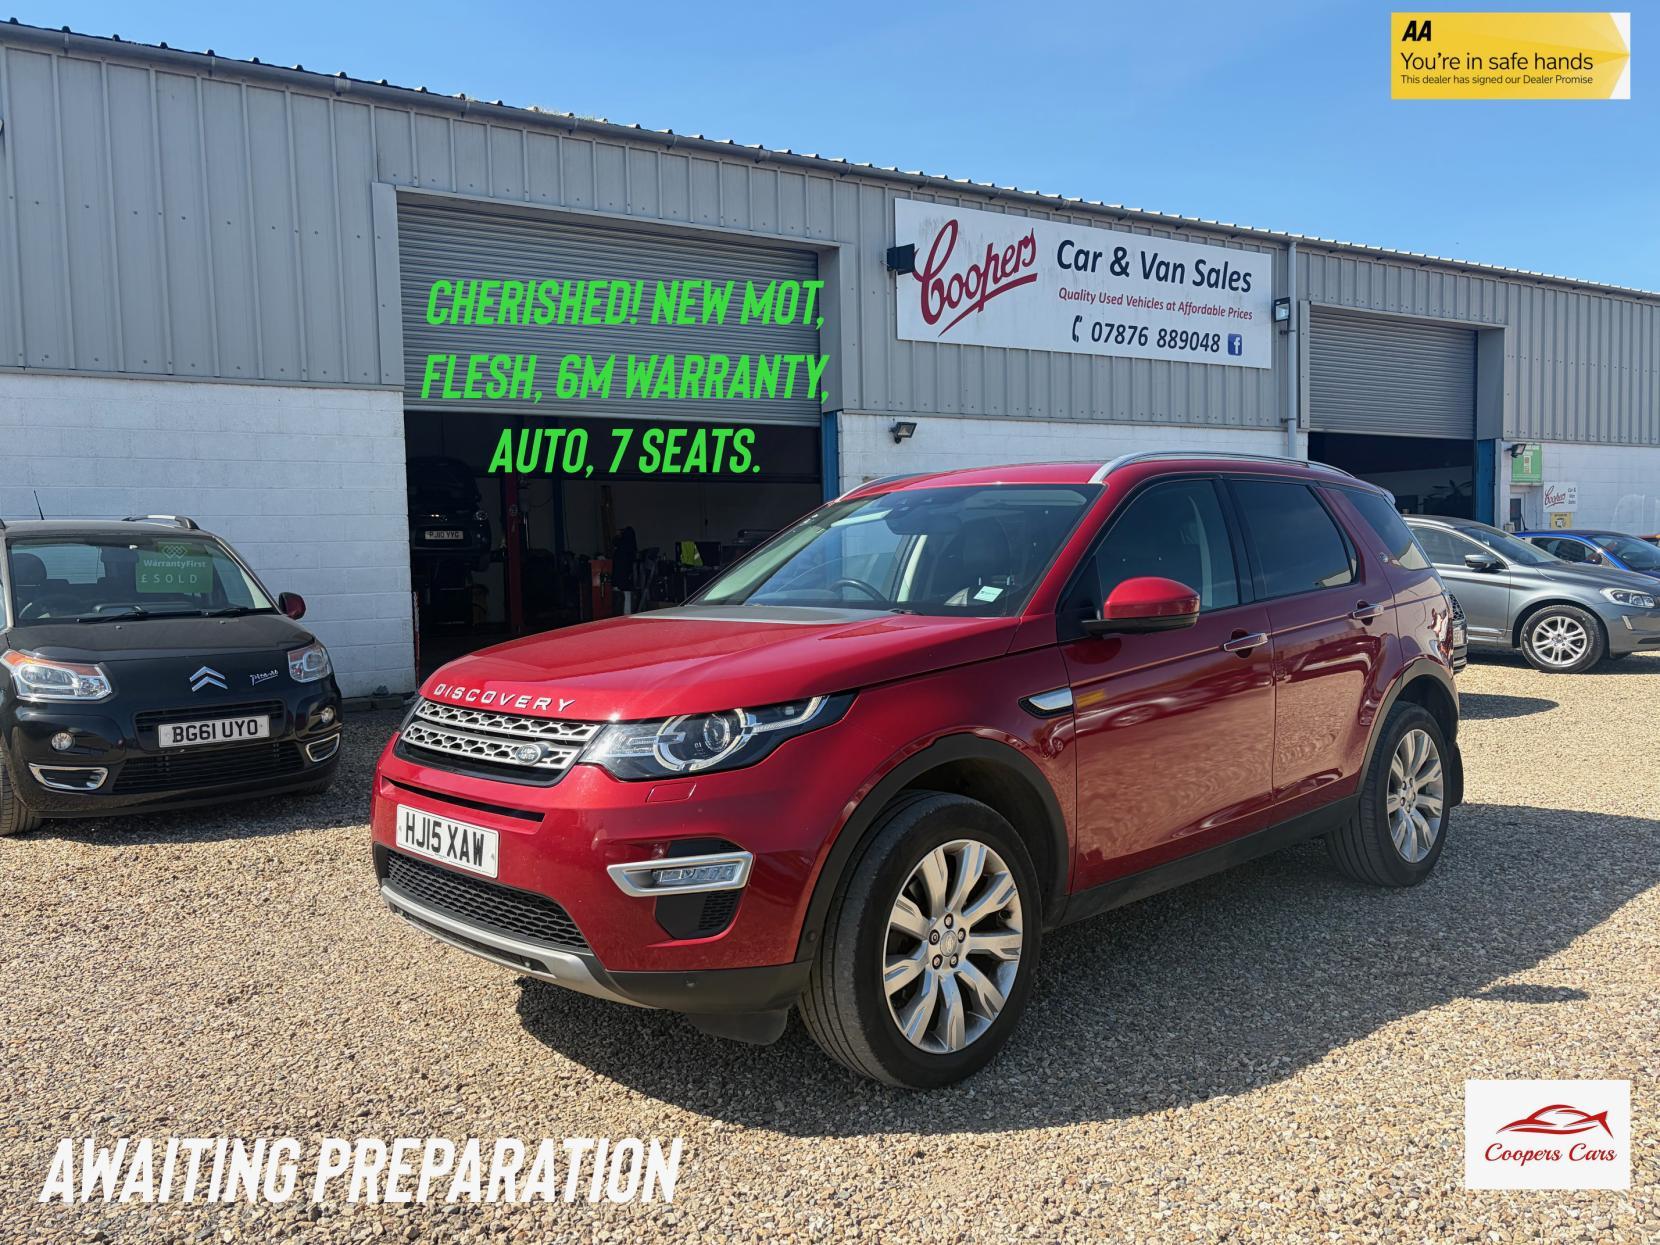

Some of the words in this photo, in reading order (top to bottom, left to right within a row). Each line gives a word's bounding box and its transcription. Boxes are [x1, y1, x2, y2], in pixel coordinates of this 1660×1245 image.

[912, 219, 1037, 326] Coopers
[1057, 239, 1102, 273] Car
[1109, 246, 1130, 278] &
[1140, 250, 1185, 284] Van
[1192, 259, 1252, 293] Sales
[1058, 287, 1096, 305] Quality
[1099, 292, 1123, 305] Used
[1126, 295, 1164, 310] Vehicles
[1166, 302, 1176, 311] at
[1178, 301, 1226, 316] Affordable
[1228, 307, 1253, 320] Prices
[1091, 321, 1149, 346] 07876
[1157, 328, 1221, 353] 889048
[433, 683, 575, 712] DISCOVERY
[172, 722, 216, 743] BG61
[222, 719, 258, 738] UYO
[405, 811, 442, 853] HJ15
[446, 824, 485, 867] XAW
